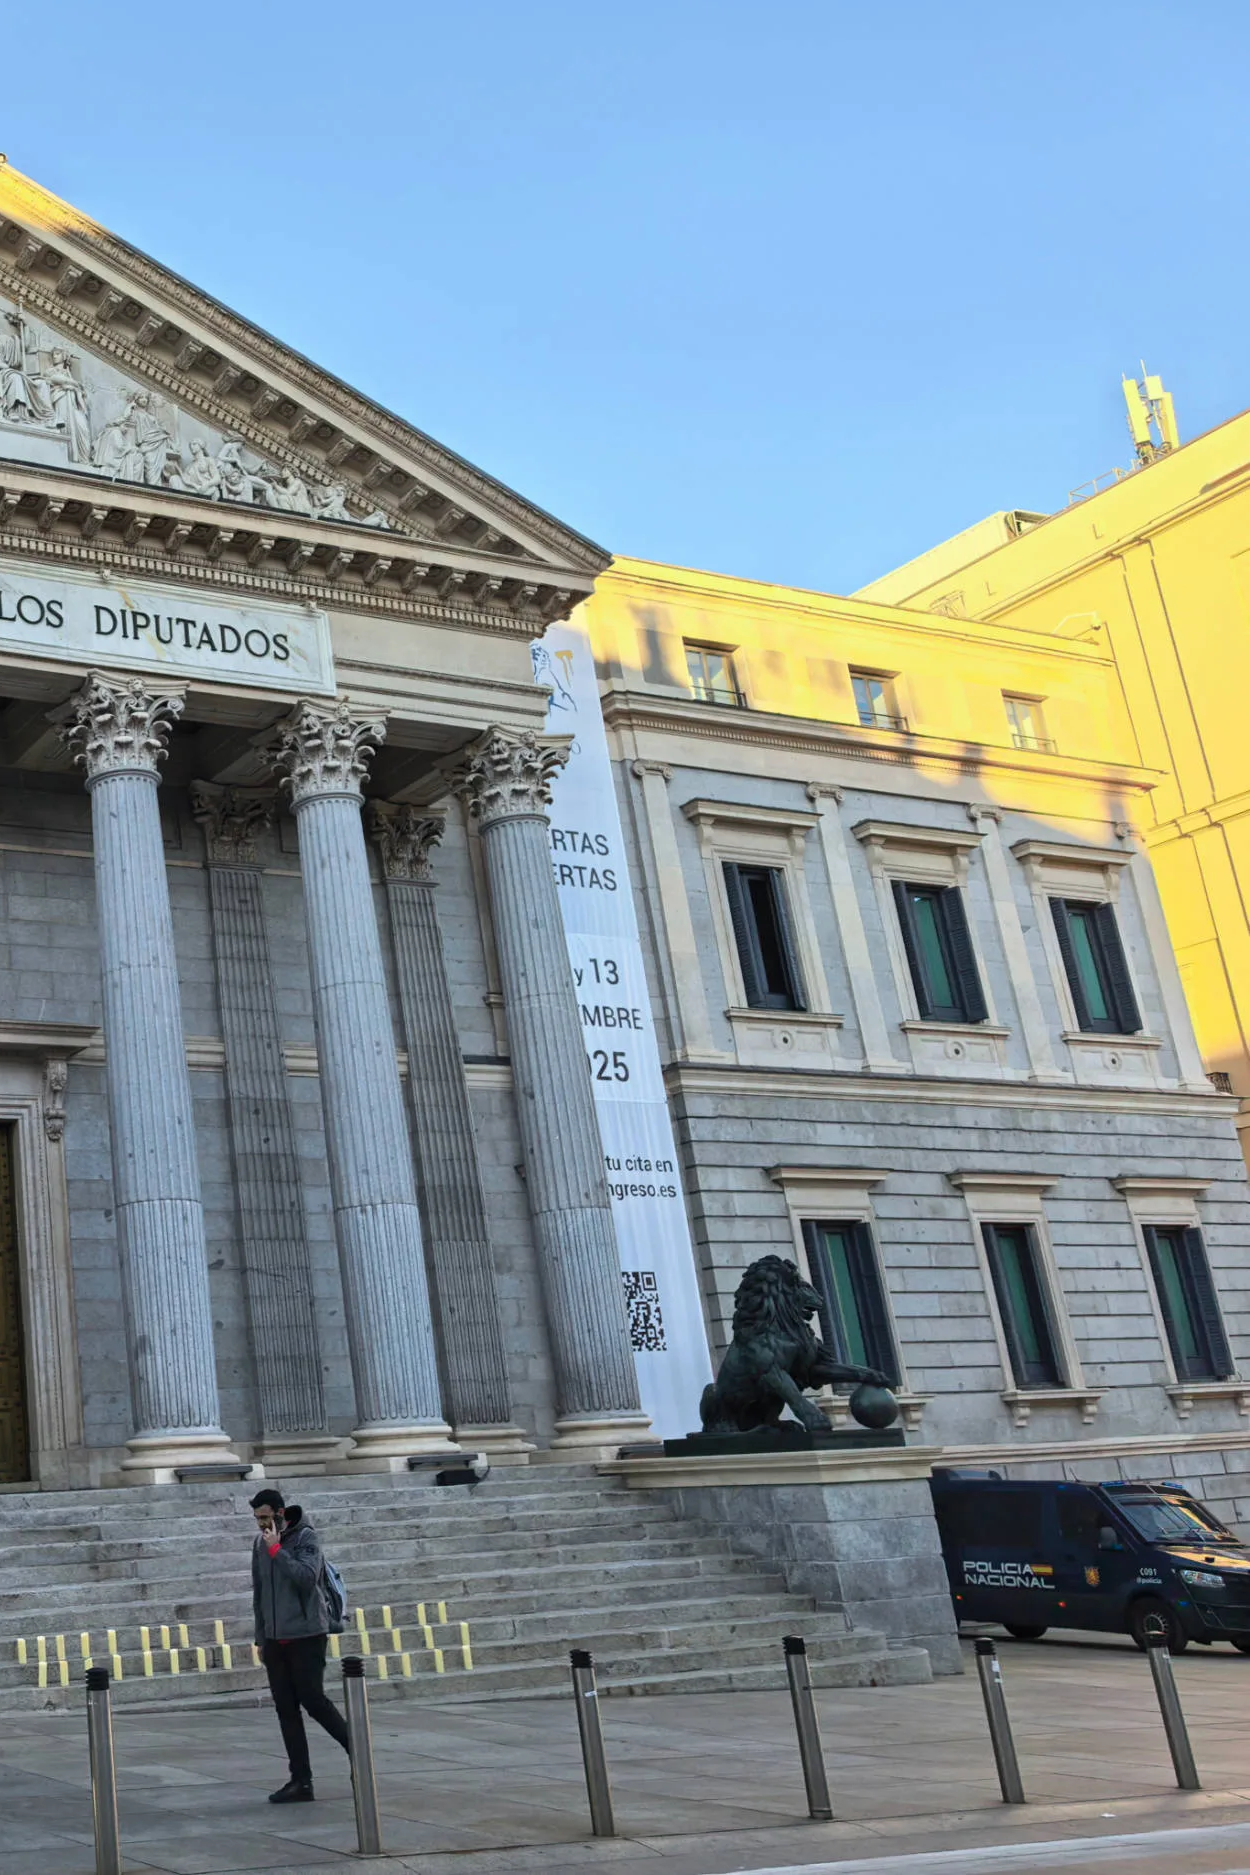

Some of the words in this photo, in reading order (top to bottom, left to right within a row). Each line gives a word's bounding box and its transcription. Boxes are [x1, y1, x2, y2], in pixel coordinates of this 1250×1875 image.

[94, 604, 291, 662] DIPUTADOS
[547, 827, 610, 856] RTAS
[573, 967, 583, 987] y
[589, 958, 619, 985] 13
[587, 1050, 630, 1082] 25
[605, 1155, 621, 1171] tu
[625, 1154, 653, 1172] cita
[655, 1159, 673, 1173] en
[963, 1561, 1034, 1575] POLICIA
[965, 1573, 1056, 1589] NACIONAL
